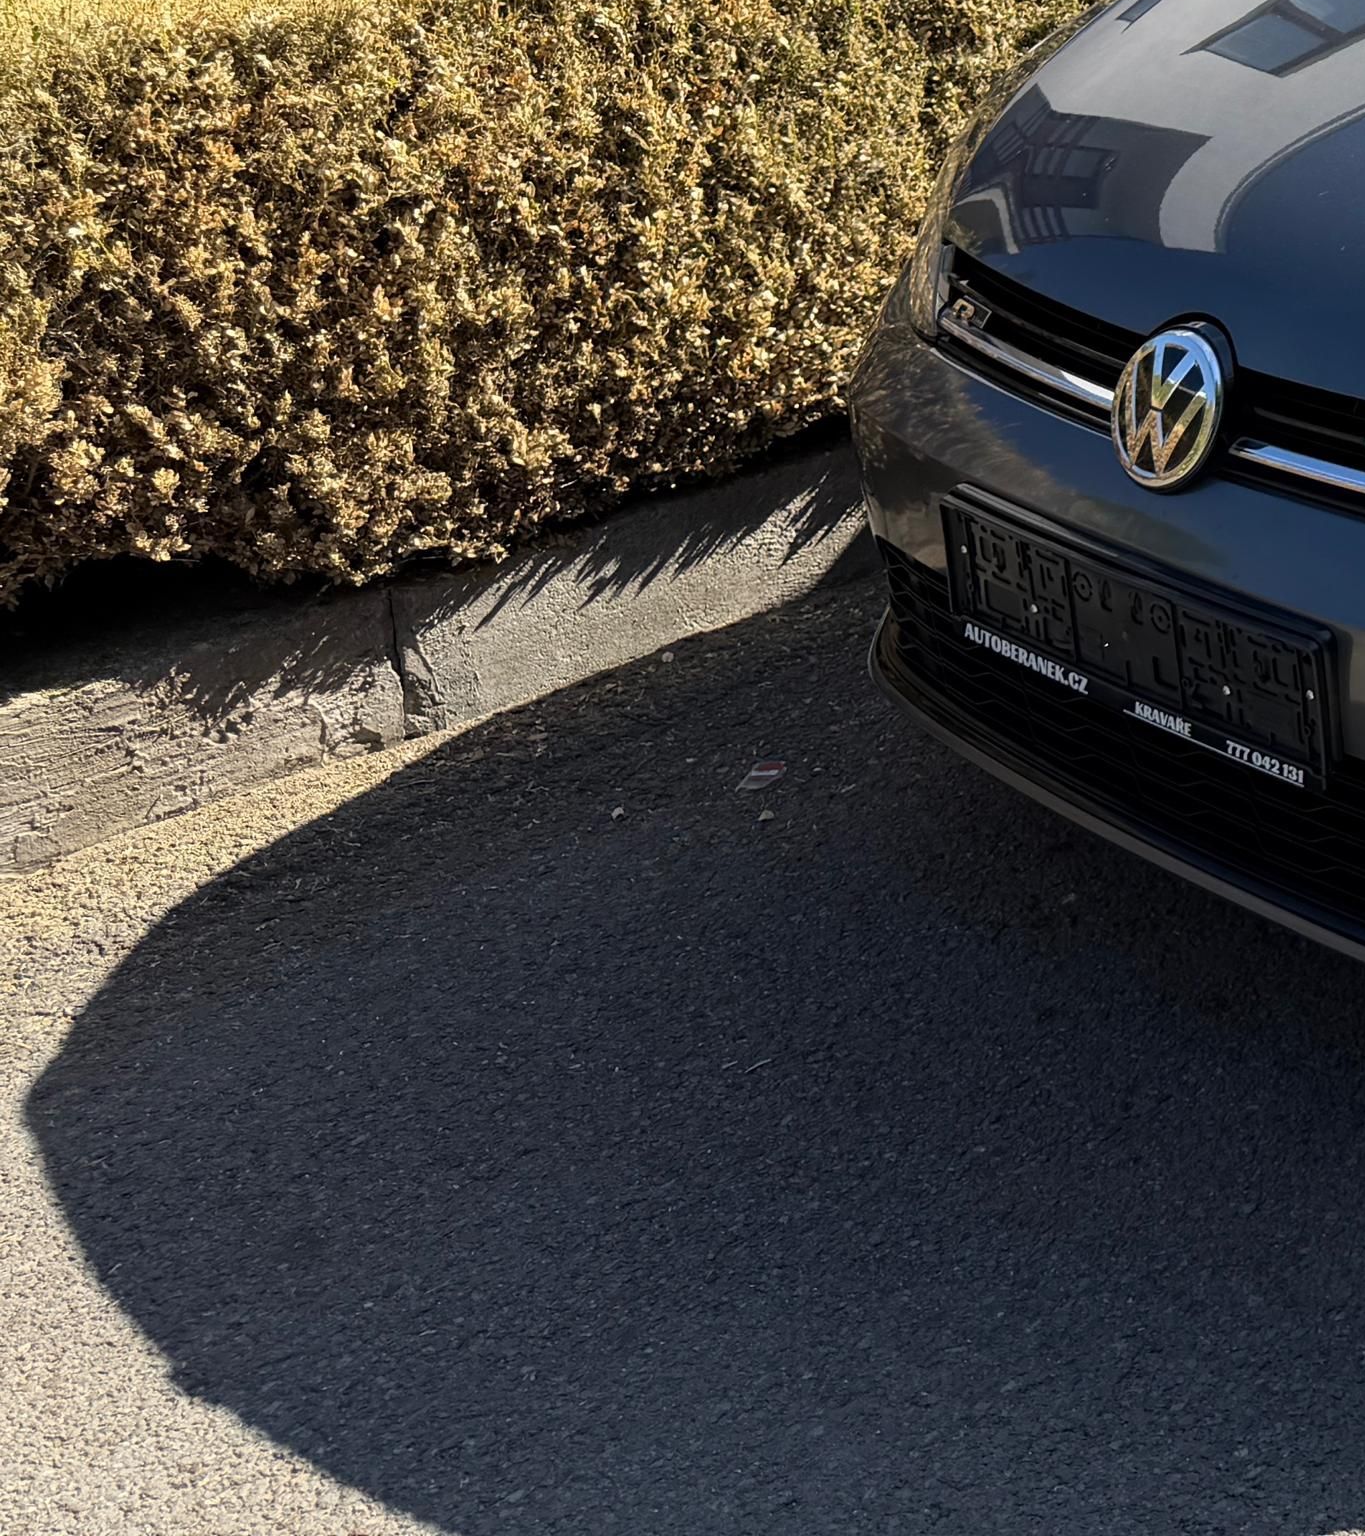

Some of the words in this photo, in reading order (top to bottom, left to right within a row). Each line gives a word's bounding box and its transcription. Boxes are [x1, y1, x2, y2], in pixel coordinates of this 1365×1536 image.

[964, 622, 1090, 696] AUTOBERANEK.CZ
[1134, 700, 1193, 738] KRAVAŘE
[1226, 739, 1251, 761] 777
[1251, 751, 1281, 775] 042
[1281, 763, 1305, 784] 131
